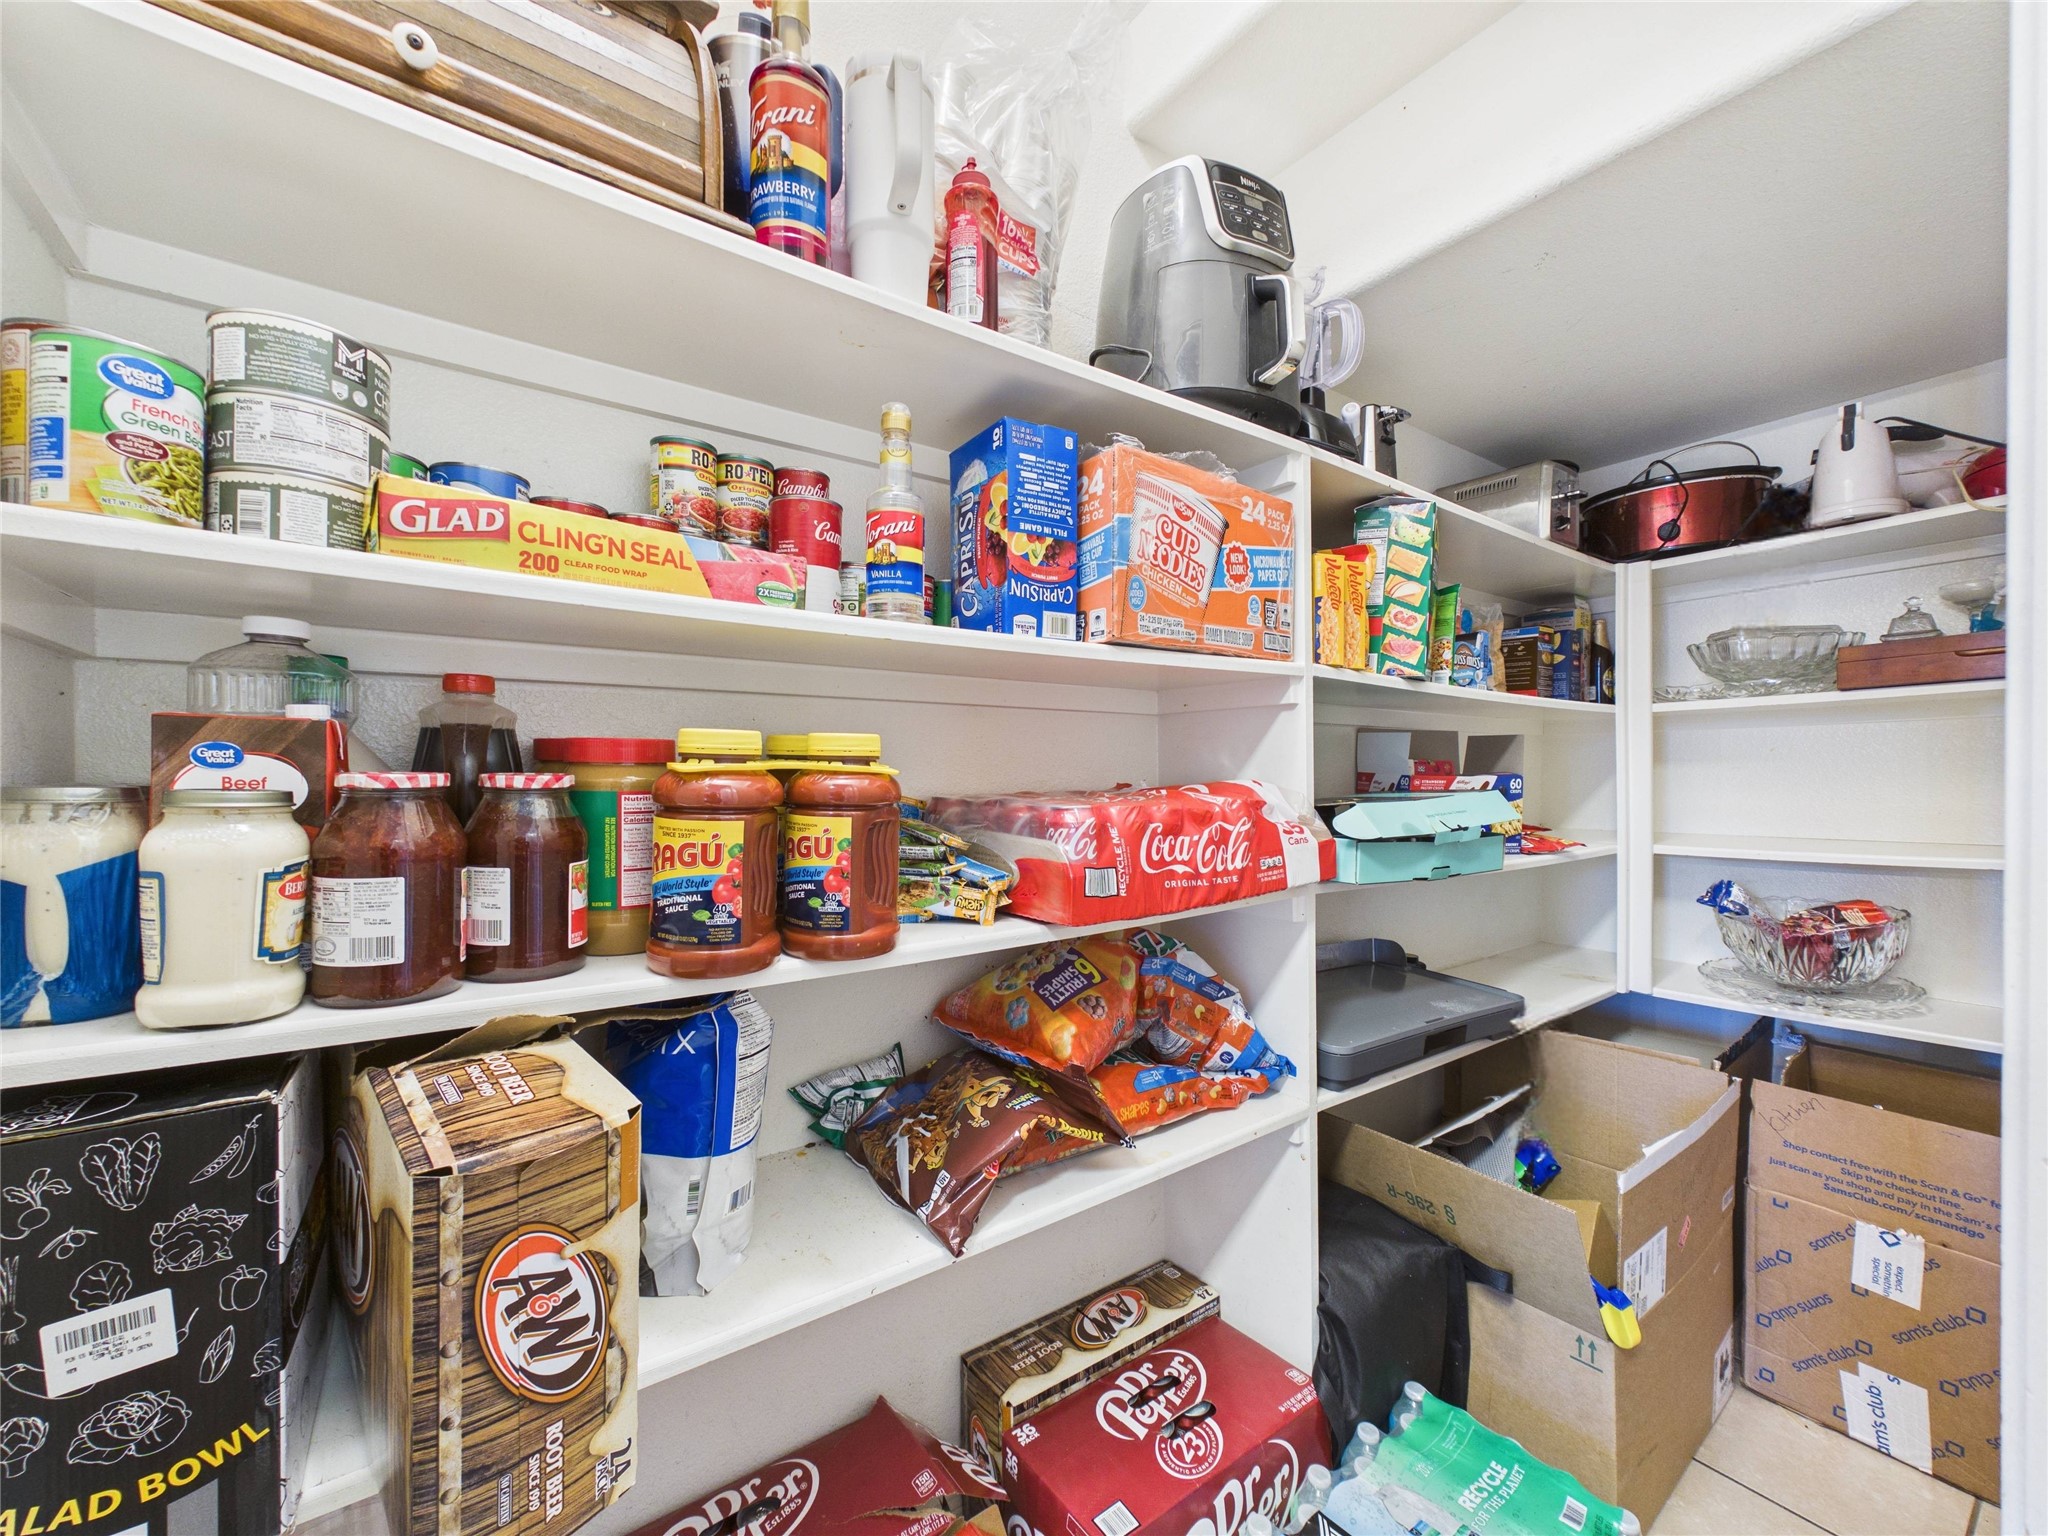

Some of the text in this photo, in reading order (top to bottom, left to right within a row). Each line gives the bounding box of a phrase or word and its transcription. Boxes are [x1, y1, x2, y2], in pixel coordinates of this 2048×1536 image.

[1240, 175, 1261, 191] NINJA
[998, 242, 1038, 270] CUPS
[107, 359, 165, 387] Great
[334, 361, 366, 380] Member's
[121, 375, 165, 395] Value
[121, 412, 181, 440] Green
[132, 399, 190, 430] French
[116, 439, 134, 447] and
[126, 435, 154, 447] Picked
[731, 484, 768, 497] Original
[1077, 468, 1105, 502] 24
[389, 499, 505, 534] GLAD
[1079, 500, 1100, 513] PACK
[1092, 508, 1105, 520] OZ
[1173, 500, 1193, 518] NISSIN
[1241, 495, 1267, 526] 24
[1267, 507, 1285, 522] PACK
[866, 513, 916, 546] Torani
[1019, 522, 1068, 538] FILL IN GAME
[1156, 513, 1201, 558] CUP
[1267, 519, 1282, 531] 2.25
[519, 550, 648, 579] 200 CLEAR FOOD WRAP
[630, 541, 693, 572] SEAL
[1137, 528, 1206, 593] NOODLES
[1230, 553, 1244, 565] NEW
[871, 570, 902, 579] VANILLA
[1142, 564, 1183, 594] CHICKEN
[1229, 564, 1247, 576] LOOK!
[1257, 569, 1277, 583] PAPER
[758, 587, 770, 597] 2X
[1009, 578, 1074, 605] CAPRISUN
[1129, 589, 1144, 598] ADDED
[1324, 556, 1343, 611] Velveeta
[1346, 563, 1364, 617] Velveeta
[1014, 623, 1036, 631] NATURAL
[196, 747, 235, 759] Great
[207, 756, 235, 765] Value
[221, 776, 268, 791] Beef
[1400, 777, 1410, 786] 60
[1509, 778, 1523, 790] 60
[1139, 816, 1252, 876] Coca-Cola
[1287, 836, 1309, 846] Cans
[801, 868, 822, 879] Style
[1114, 845, 1127, 897] RECYCLE
[1164, 874, 1239, 889] ORIGINAL TASTE
[662, 878, 710, 892] World Style
[789, 891, 805, 900] SAUCE
[657, 894, 703, 908] TRADITIONAL
[665, 904, 689, 914] SAUCE
[713, 903, 734, 914] 40%
[1039, 965, 1080, 996] SHAPES
[1047, 974, 1088, 1007] FRUITY
[464, 1064, 489, 1084] SINCE
[497, 1074, 535, 1106] BEER
[1782, 1140, 1961, 1198] Shop contact free with the Scan &
[1386, 1180, 1437, 1215] 296-R
[1769, 1156, 1992, 1231] Just scan as you shop and pay in the Sam's
[1840, 1167, 1965, 1211] Skip the checkout line.
[1823, 1182, 1986, 1241] SamsClub.com/scanandgo
[1809, 1229, 1846, 1252] sam's
[1871, 1257, 1881, 1285] special
[1895, 1266, 1905, 1293] expect
[1799, 1293, 1833, 1314] sam's
[491, 1266, 601, 1367] A&W
[1092, 1293, 1134, 1342] A&W
[1891, 1323, 1934, 1346] sam's
[1010, 1340, 1064, 1371] ROOT BEER
[1791, 1353, 1828, 1373] sam's
[1115, 1362, 1158, 1397] Dr
[1011, 1423, 1038, 1442] 36
[1020, 1431, 1040, 1447] PACK
[1172, 1431, 1206, 1463] 23
[137, 1421, 270, 1505] BOWL
[545, 1419, 564, 1524] ROOT BEER
[609, 1437, 632, 1488] 24
[1162, 1450, 1210, 1475] AUTHENTIC BLEND
[528, 1453, 541, 1512] SINCE 1919
[596, 1456, 609, 1501] PACK
[915, 1471, 931, 1487] 150
[1457, 1459, 1509, 1513] RECYCLE
[1471, 1462, 1526, 1534] FOR THE PLANET
